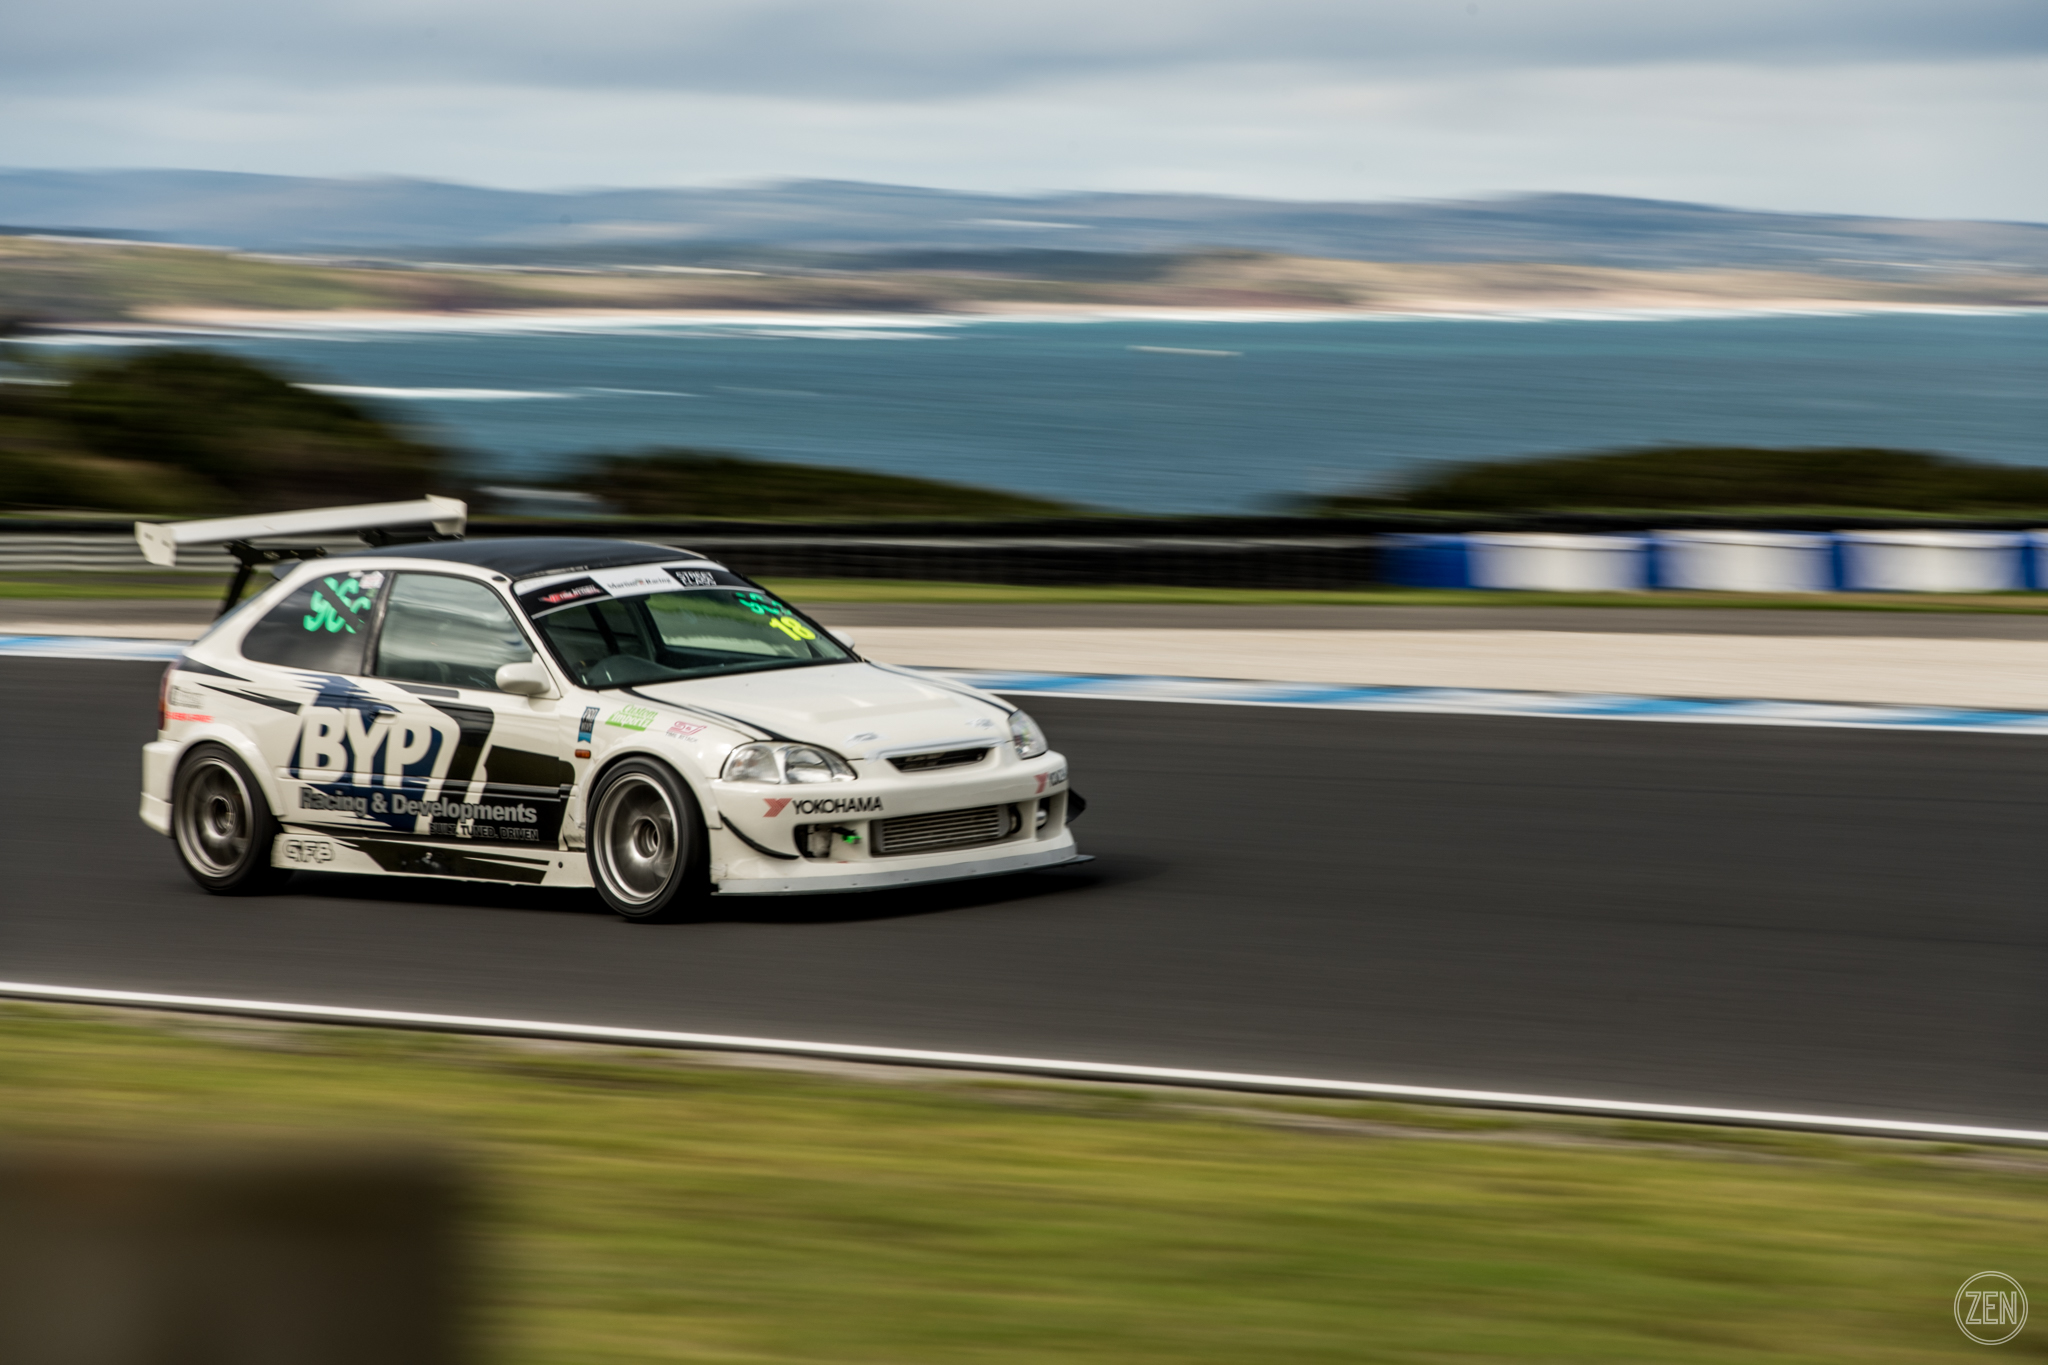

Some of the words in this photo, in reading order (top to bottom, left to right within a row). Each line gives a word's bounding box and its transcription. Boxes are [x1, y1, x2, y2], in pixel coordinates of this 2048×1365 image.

[769, 616, 816, 641] 18
[622, 703, 659, 720] Custom
[299, 705, 432, 788] BYP
[299, 786, 368, 818] Racing
[370, 791, 390, 813] &
[391, 793, 538, 824] Developments
[792, 796, 884, 815] YOKOHAMA
[500, 827, 540, 841] DRIVEN
